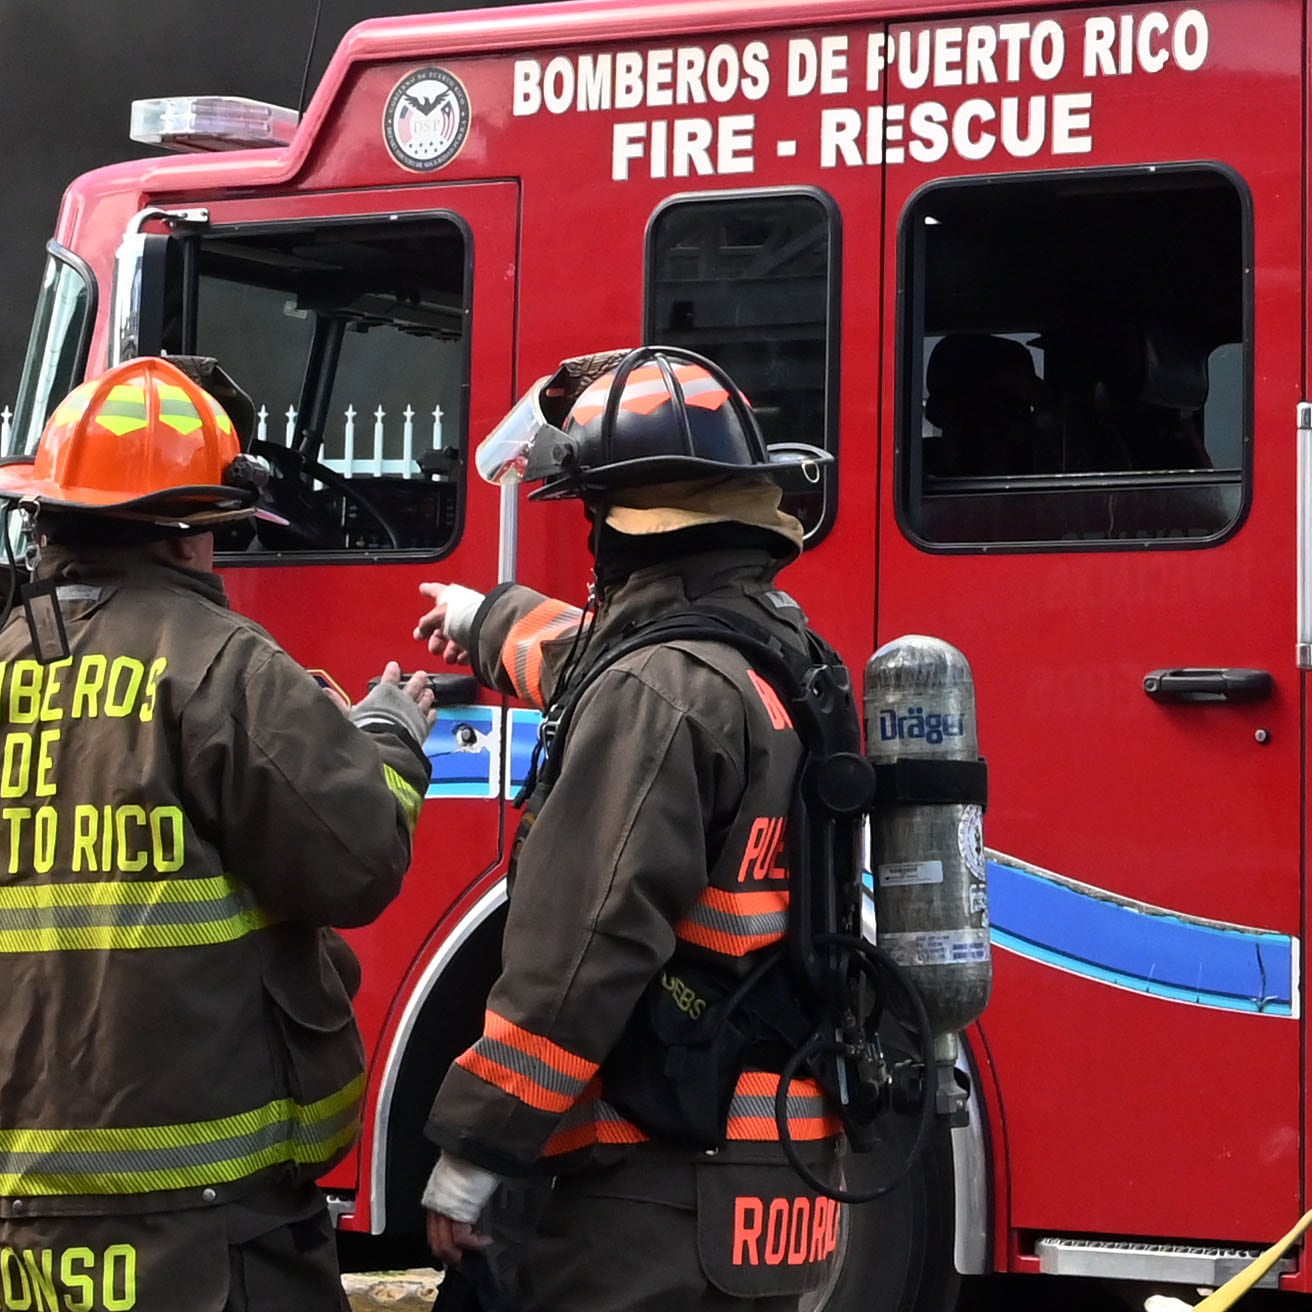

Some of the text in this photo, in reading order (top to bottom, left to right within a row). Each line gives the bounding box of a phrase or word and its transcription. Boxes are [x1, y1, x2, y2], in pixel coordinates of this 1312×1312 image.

[513, 9, 1209, 117] BOMBEROS DE PUERTO RICO
[611, 114, 755, 181] FIRE
[820, 92, 1092, 168] RESCUE
[880, 706, 965, 744] Dräger
[0, 729, 62, 799] DE
[72, 803, 185, 873] RICO
